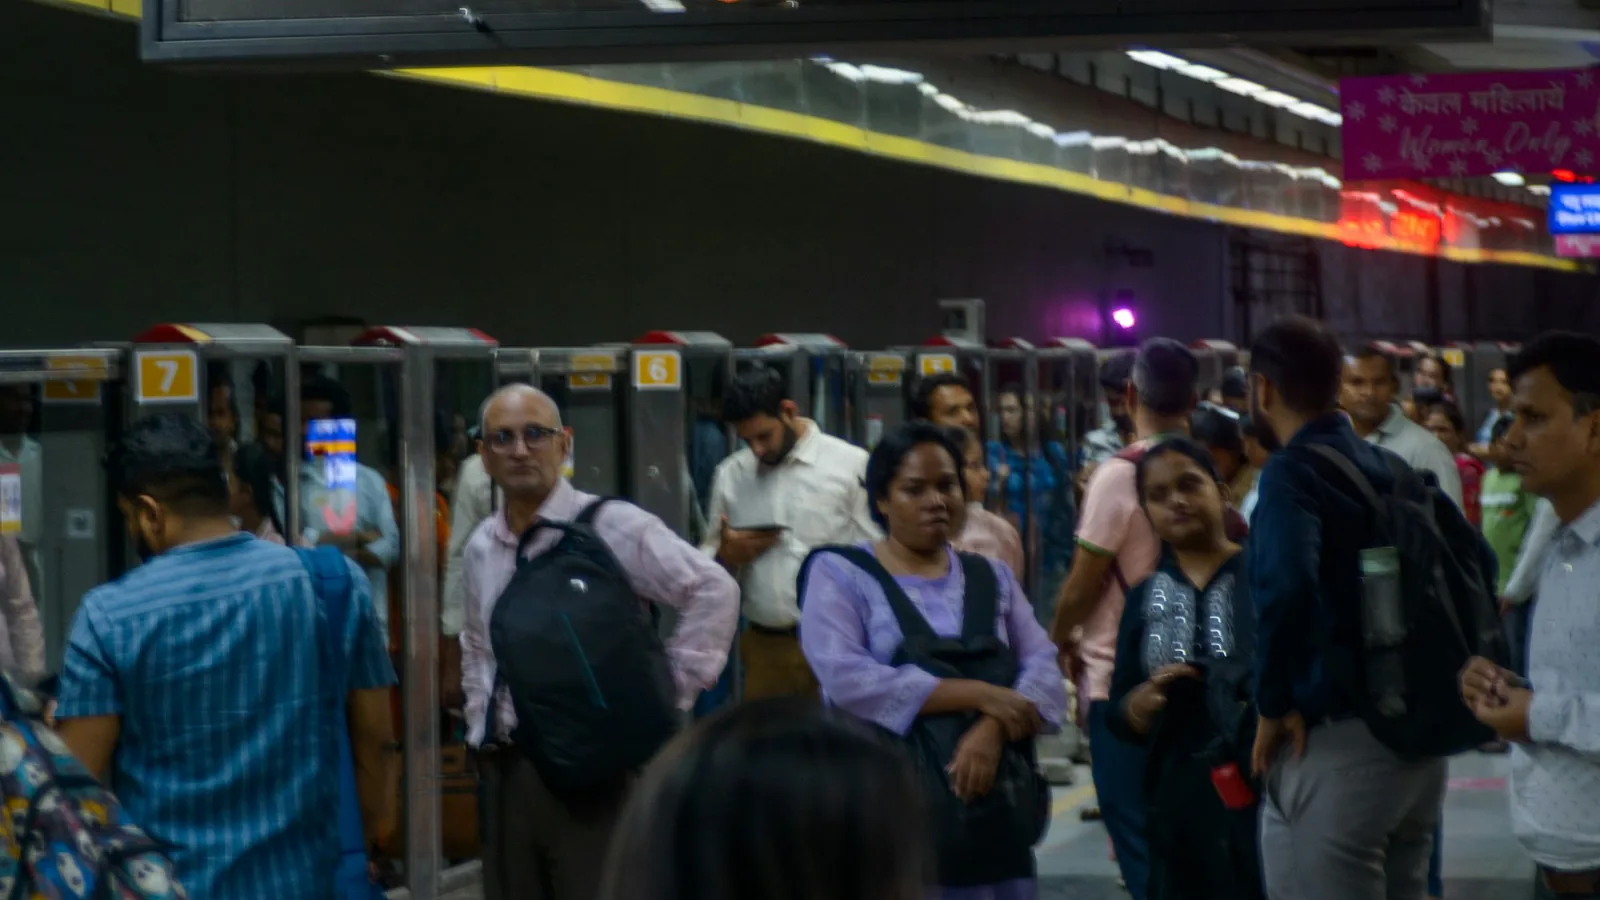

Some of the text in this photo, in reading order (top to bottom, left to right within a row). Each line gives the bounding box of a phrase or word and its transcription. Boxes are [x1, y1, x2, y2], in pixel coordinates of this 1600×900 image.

[1400, 87, 1462, 115] केवल
[1401, 121, 1572, 165] Women Only
[153, 360, 179, 393] 7
[648, 357, 668, 383] 6
